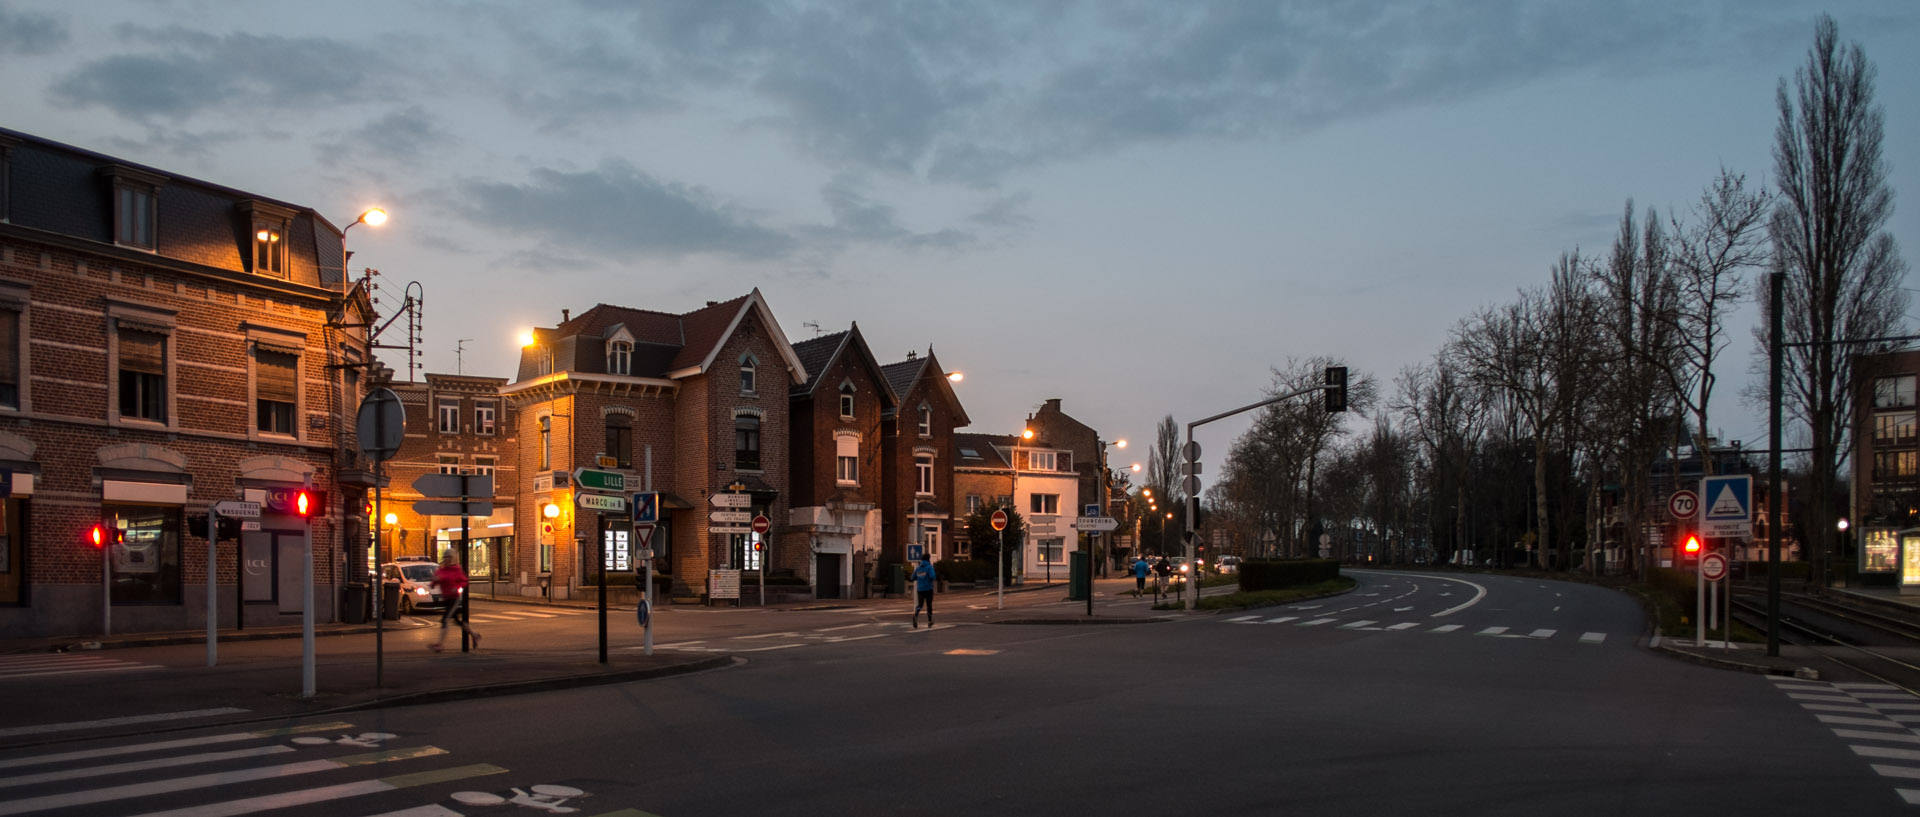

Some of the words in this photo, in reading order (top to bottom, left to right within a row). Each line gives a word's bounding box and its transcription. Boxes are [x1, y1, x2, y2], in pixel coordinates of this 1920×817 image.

[604, 475, 623, 487] LILLE
[269, 491, 289, 501] LCL
[585, 498, 608, 507] MARCQ
[1676, 499, 1693, 510] 70
[247, 559, 268, 568] LCL
